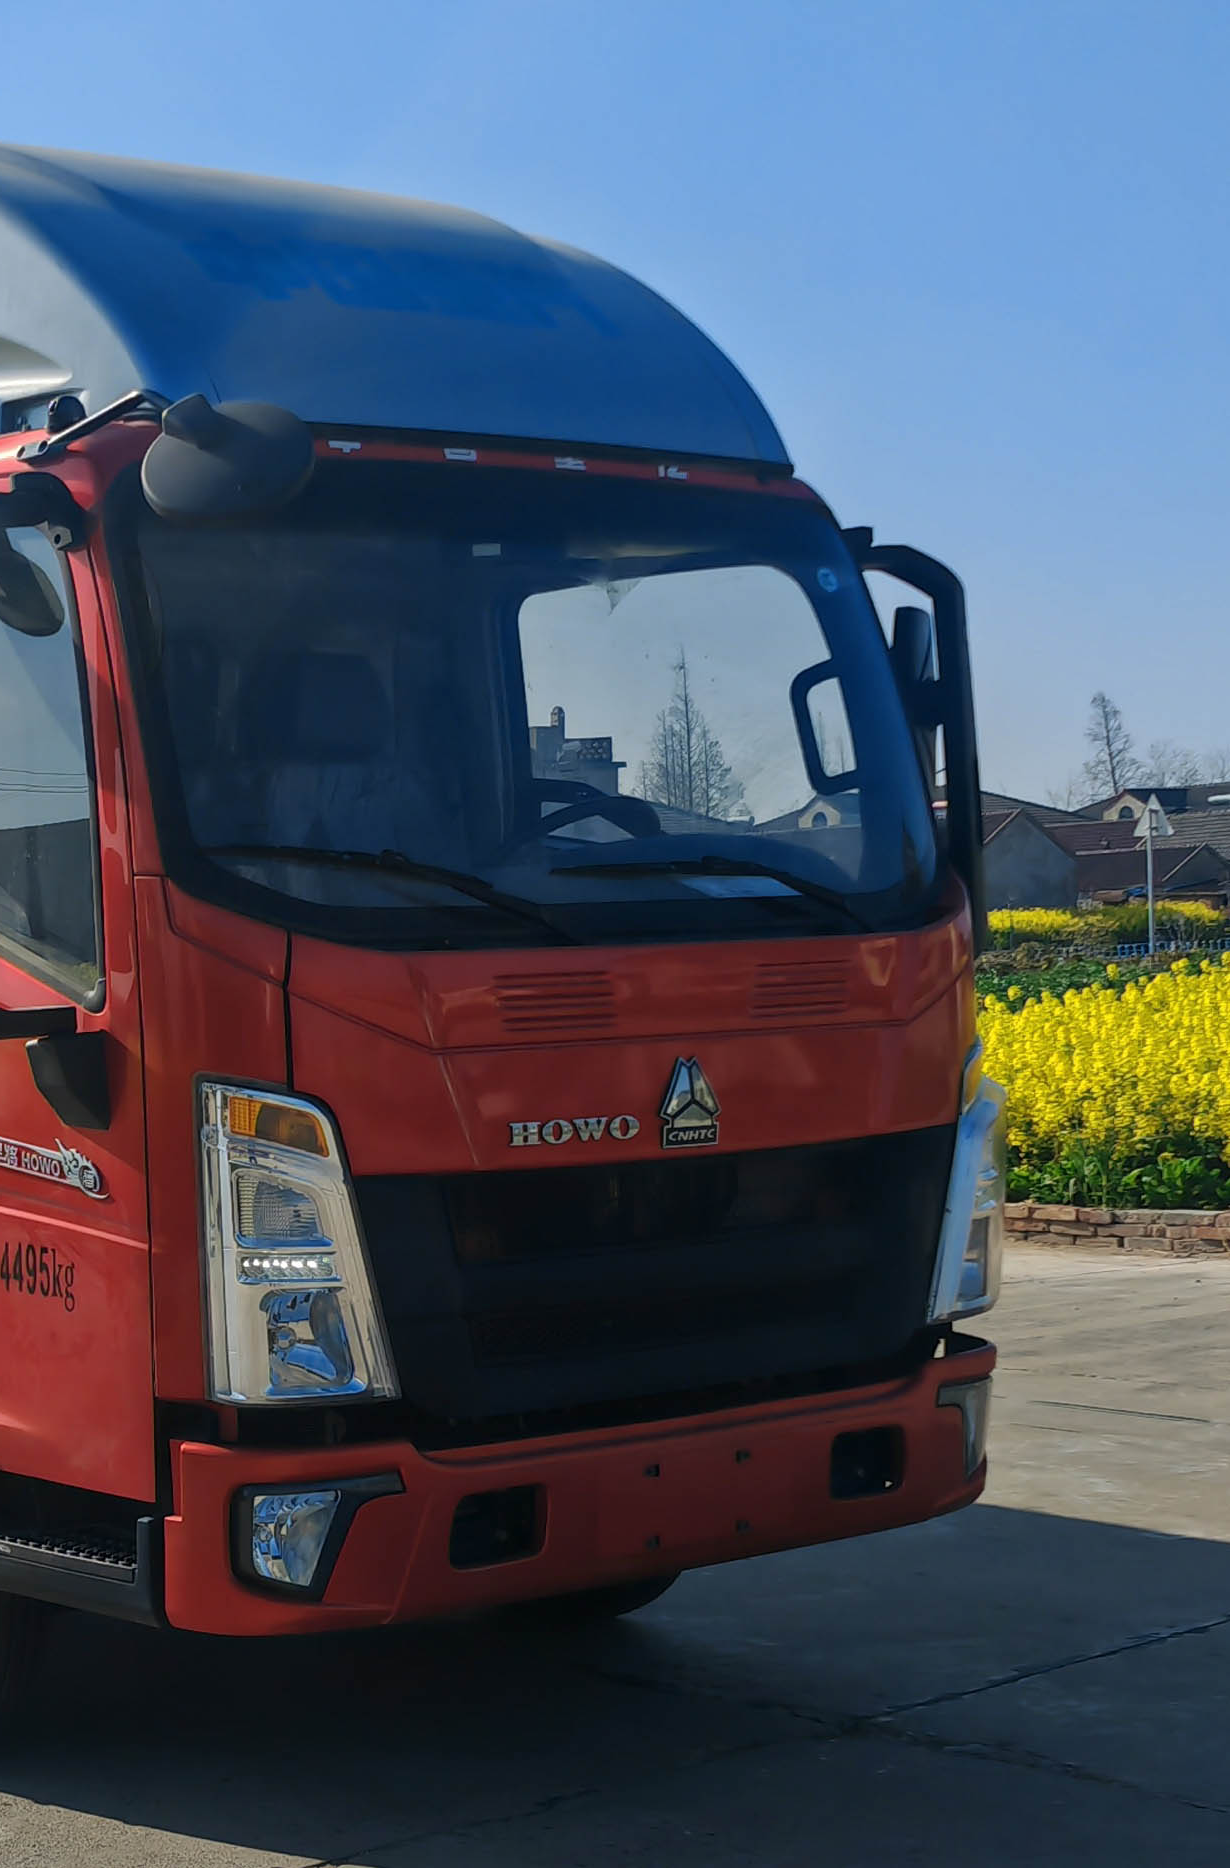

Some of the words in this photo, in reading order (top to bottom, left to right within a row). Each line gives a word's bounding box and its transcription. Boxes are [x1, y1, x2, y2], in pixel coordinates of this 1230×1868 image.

[509, 1115, 640, 1147] HOWO
[668, 1128, 716, 1143] CNHTC
[21, 1151, 61, 1177] HOWO
[0, 1241, 75, 1312] 4495kg
